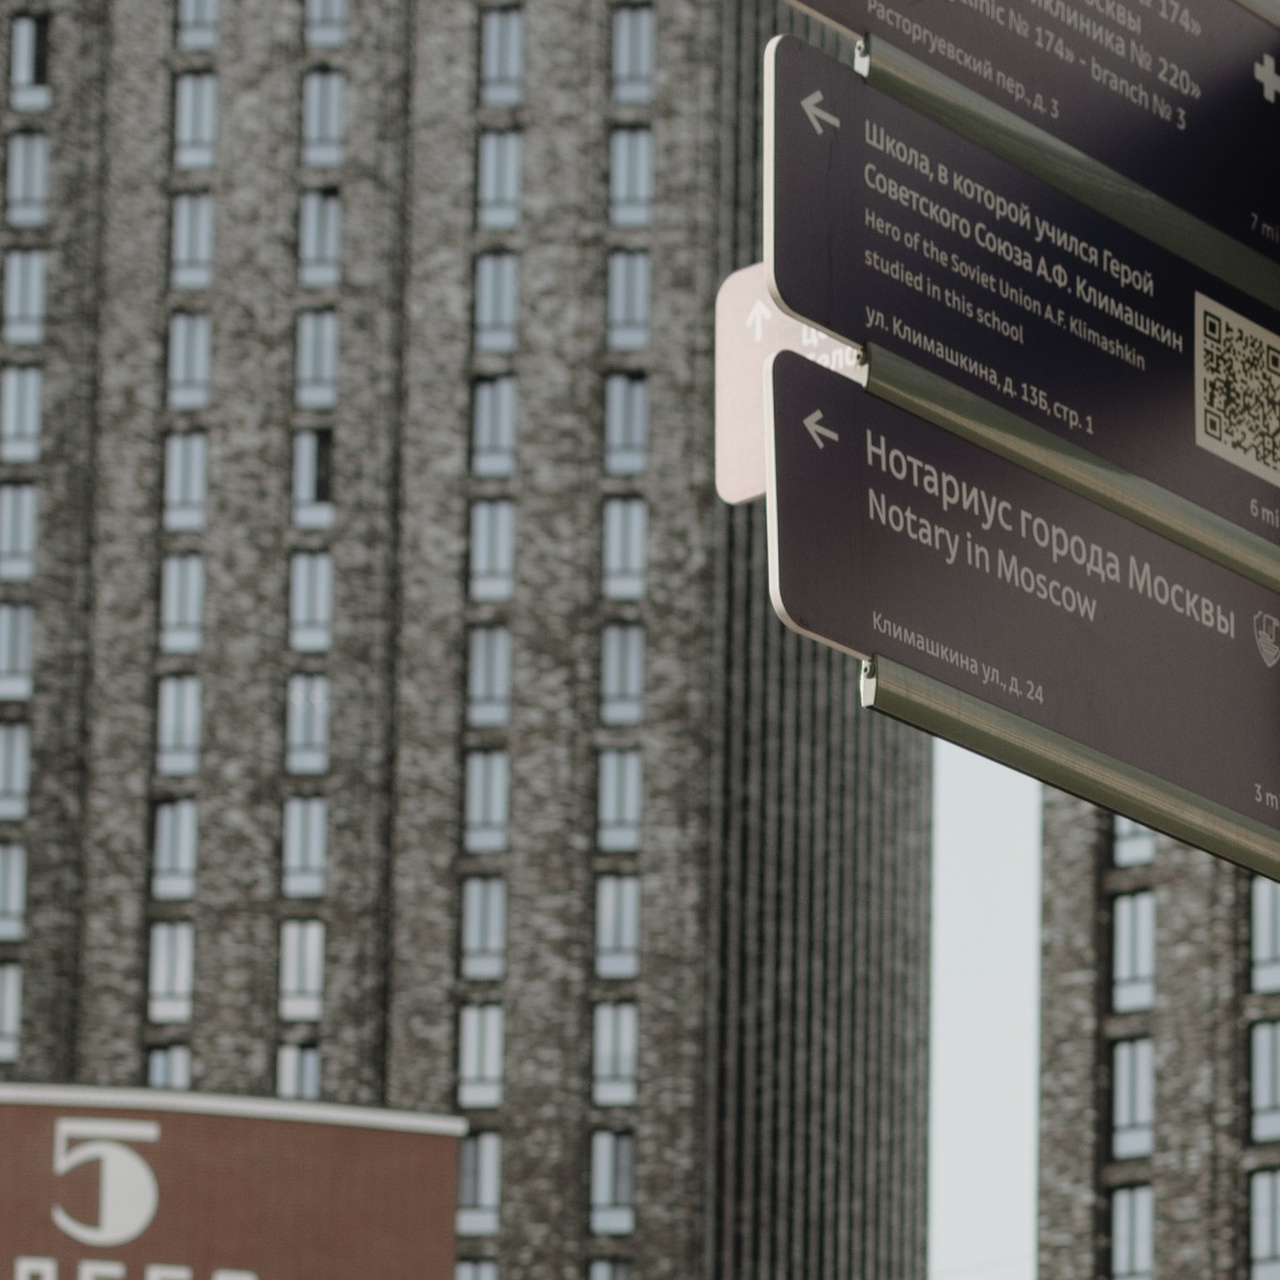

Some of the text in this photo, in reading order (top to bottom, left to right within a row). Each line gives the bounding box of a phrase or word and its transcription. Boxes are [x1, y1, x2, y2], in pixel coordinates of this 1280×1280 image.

[1050, 98, 1060, 119] 3
[1090, 55, 1149, 111] branch
[1175, 107, 1187, 131] 3
[1157, 56, 1201, 99] 220»
[864, 118, 1155, 298] Школа, в которой учился Герой
[1250, 211, 1259, 231] 7
[863, 162, 971, 240] Советского
[974, 221, 1034, 273] Союза
[1075, 274, 1184, 354] Климашкин
[864, 207, 901, 243] Hero
[903, 230, 921, 252] of
[922, 238, 949, 268] the
[950, 252, 997, 294] Soviet
[999, 277, 1042, 317] Union
[1069, 315, 1146, 372] Klimashkin
[864, 249, 1025, 346] studied in this school
[865, 305, 889, 332] ул.
[892, 315, 1001, 390] Климашкина,
[1002, 375, 1018, 399] д.
[1020, 382, 1051, 416] 13Б,
[1052, 400, 1083, 430] стр.
[1085, 414, 1095, 435] 1
[865, 427, 1236, 639] Нотариус города Москвы
[867, 486, 1098, 623] Notary in Moscow
[1250, 498, 1259, 518] 6
[871, 610, 1045, 705] Климашкина ул., д. 24
[1253, 782, 1263, 803] 3
[52, 1116, 162, 1248] 5
